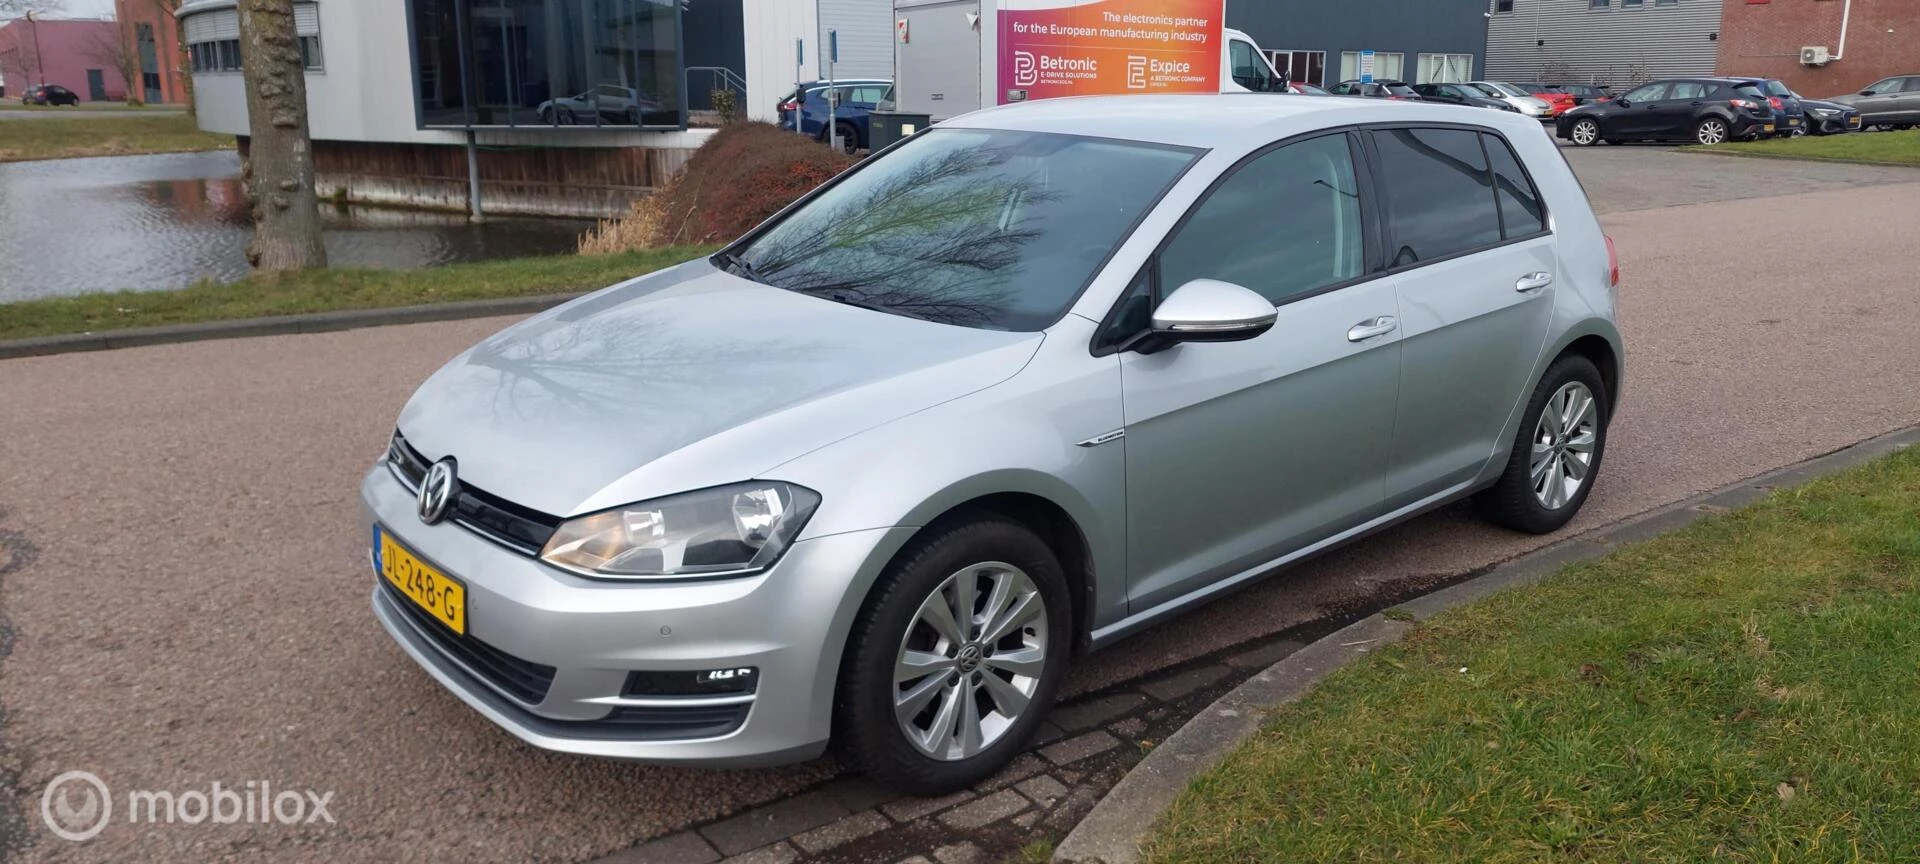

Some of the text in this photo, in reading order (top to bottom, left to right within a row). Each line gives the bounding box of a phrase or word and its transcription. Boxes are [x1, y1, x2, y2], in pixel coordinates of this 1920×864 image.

[1103, 12, 1208, 28] The electronics partner
[1013, 22, 1207, 44] for the European manufacturing industry
[1040, 55, 1097, 71] Betronic
[1150, 59, 1190, 75] Expice
[1065, 72, 1097, 80] SOLUTIONS
[387, 544, 455, 621] JL-248-G
